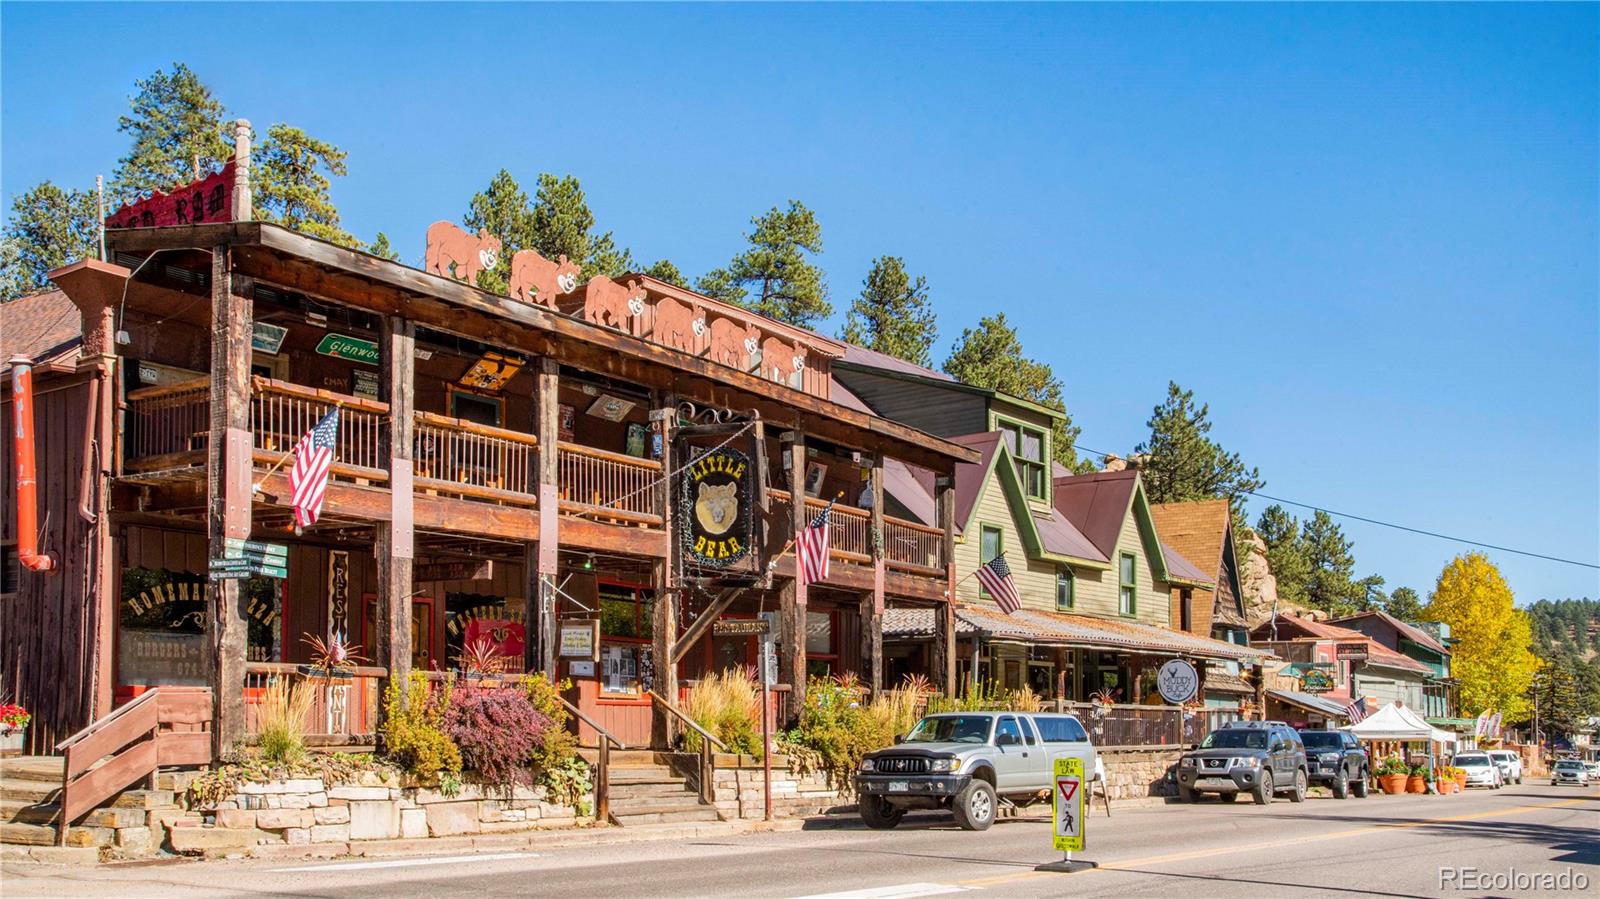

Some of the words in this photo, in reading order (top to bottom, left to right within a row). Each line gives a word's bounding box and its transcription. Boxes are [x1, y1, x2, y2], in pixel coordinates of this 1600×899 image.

[690, 455, 746, 481] LITTLE
[694, 536, 741, 558] BEAR
[128, 582, 208, 616] HOMEMAD
[247, 597, 276, 627] ZZA
[137, 641, 187, 658] BURGERS
[1163, 676, 1192, 685] MUDDY
[1166, 684, 1190, 693] BUCK
